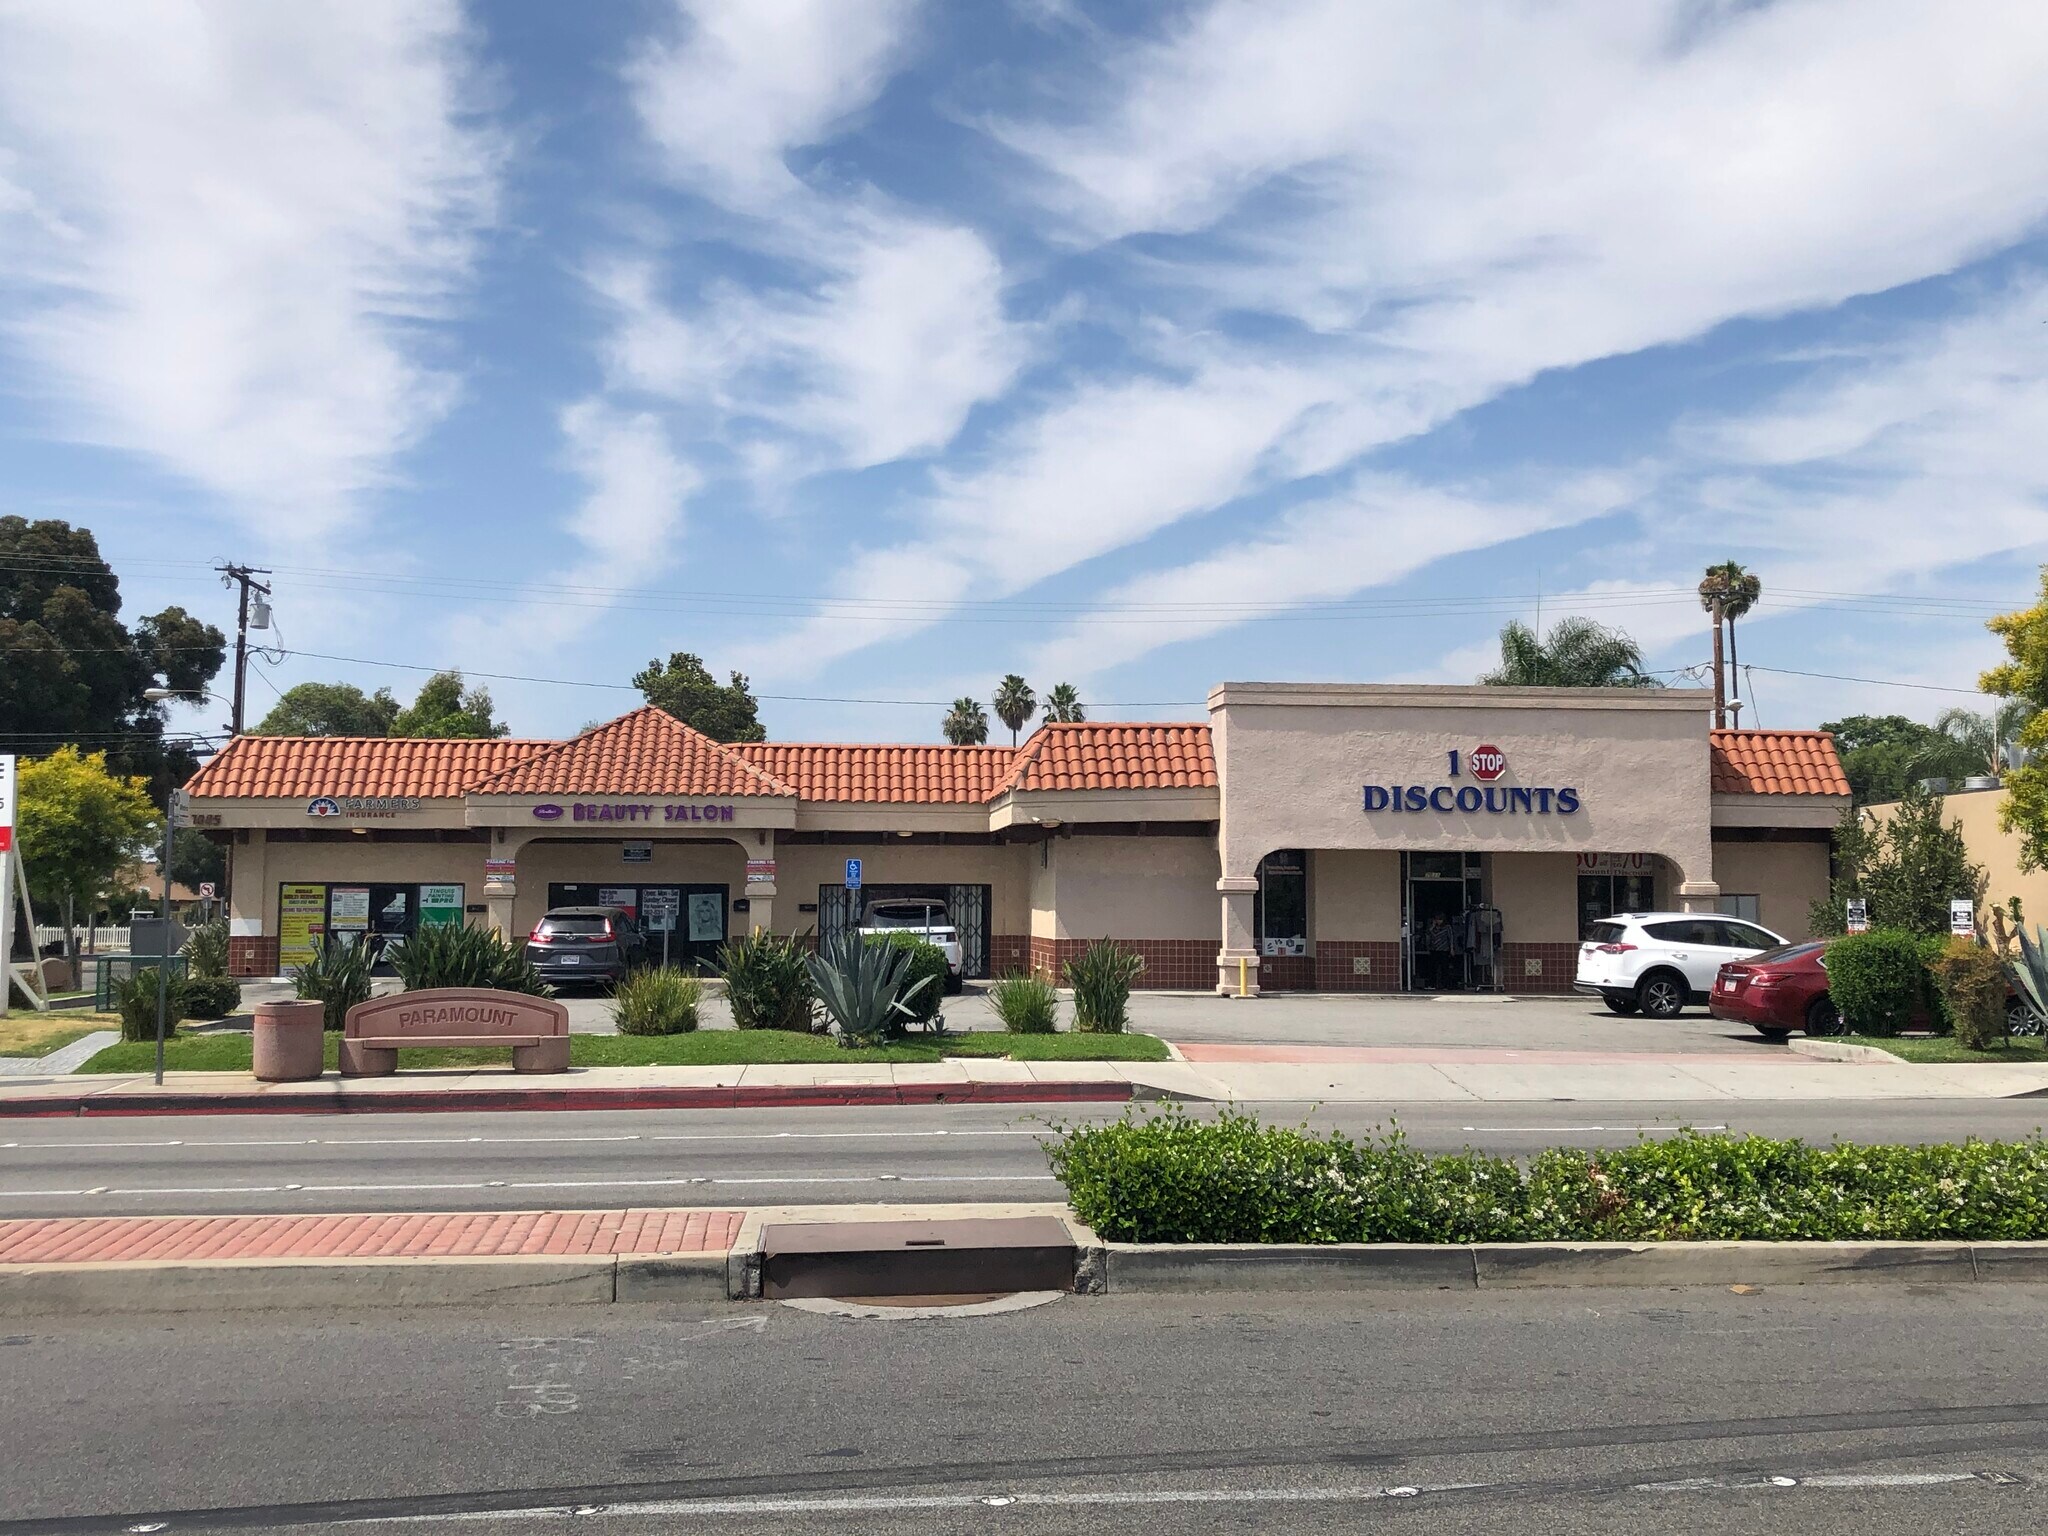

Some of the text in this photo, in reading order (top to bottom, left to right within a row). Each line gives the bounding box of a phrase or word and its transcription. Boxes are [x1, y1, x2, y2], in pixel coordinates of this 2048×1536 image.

[1447, 750, 1503, 777] 1 STOP
[345, 798, 420, 810] FARMERS
[1362, 785, 1580, 814] DISCOUNTS
[345, 811, 396, 819] INSURANCE
[573, 802, 734, 822] BEAUTY SALON
[399, 1007, 519, 1029] PARAMOUNT
